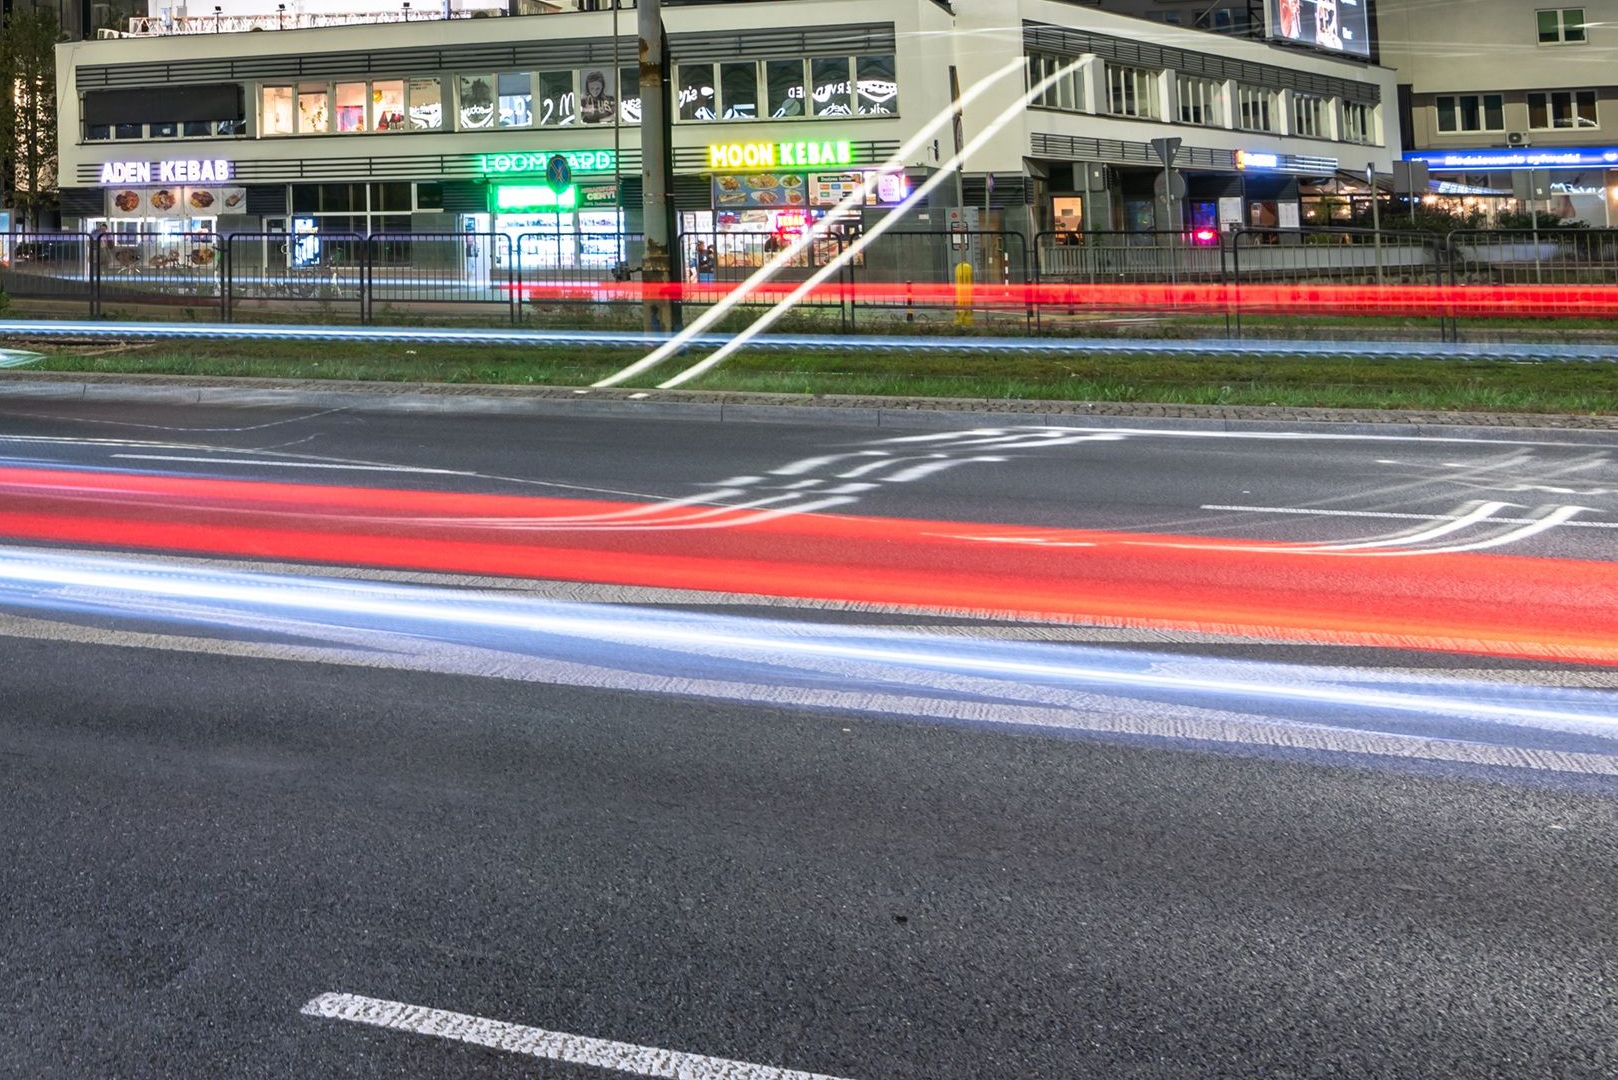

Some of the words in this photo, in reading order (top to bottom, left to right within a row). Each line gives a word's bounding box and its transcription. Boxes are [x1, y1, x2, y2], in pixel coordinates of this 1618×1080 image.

[482, 152, 611, 171] LOOMARD
[710, 143, 774, 167] MOON
[779, 141, 851, 165] KEBAB
[101, 161, 151, 182] ADEN
[160, 159, 229, 181] KEBAB
